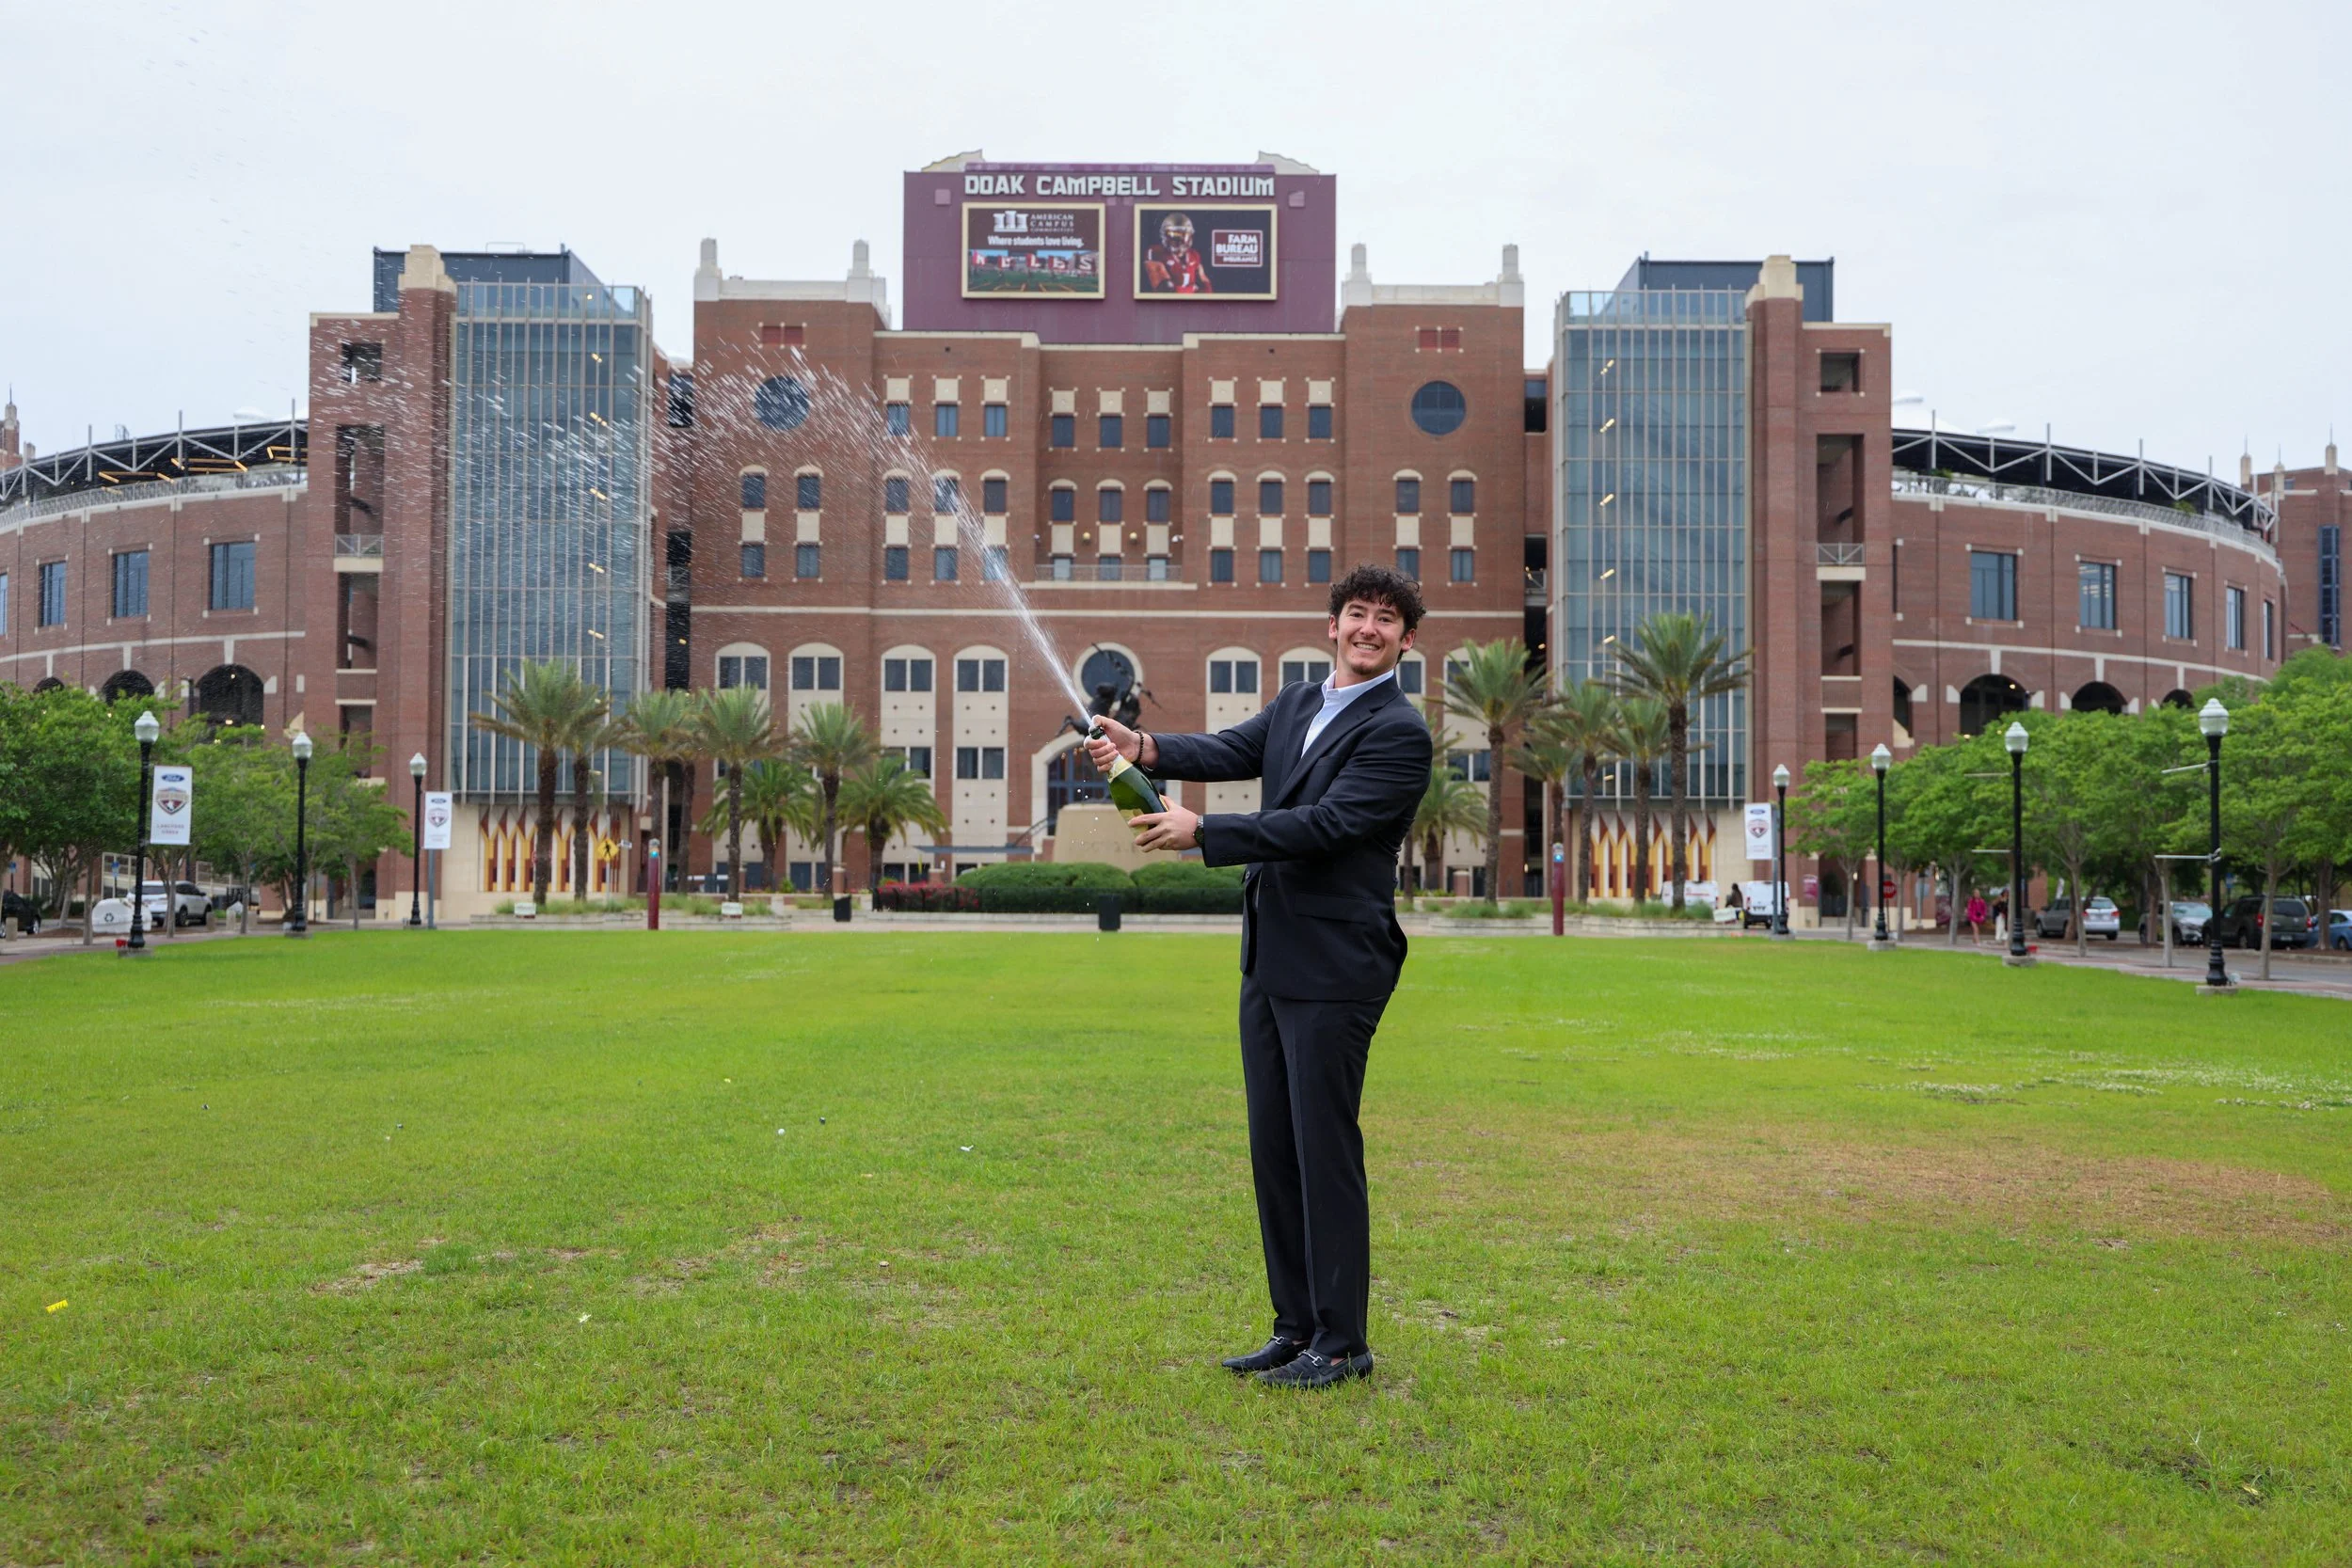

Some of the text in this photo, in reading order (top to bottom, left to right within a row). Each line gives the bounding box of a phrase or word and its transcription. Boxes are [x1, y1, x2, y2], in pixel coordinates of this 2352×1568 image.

[964, 175, 1275, 197] DOAK CAMPBELL STADIUM
[988, 235, 1012, 245] Where
[1012, 235, 1045, 245] students
[1045, 235, 1061, 245] love
[1228, 234, 1258, 244] FARM
[1216, 244, 1259, 254] BUREAU
